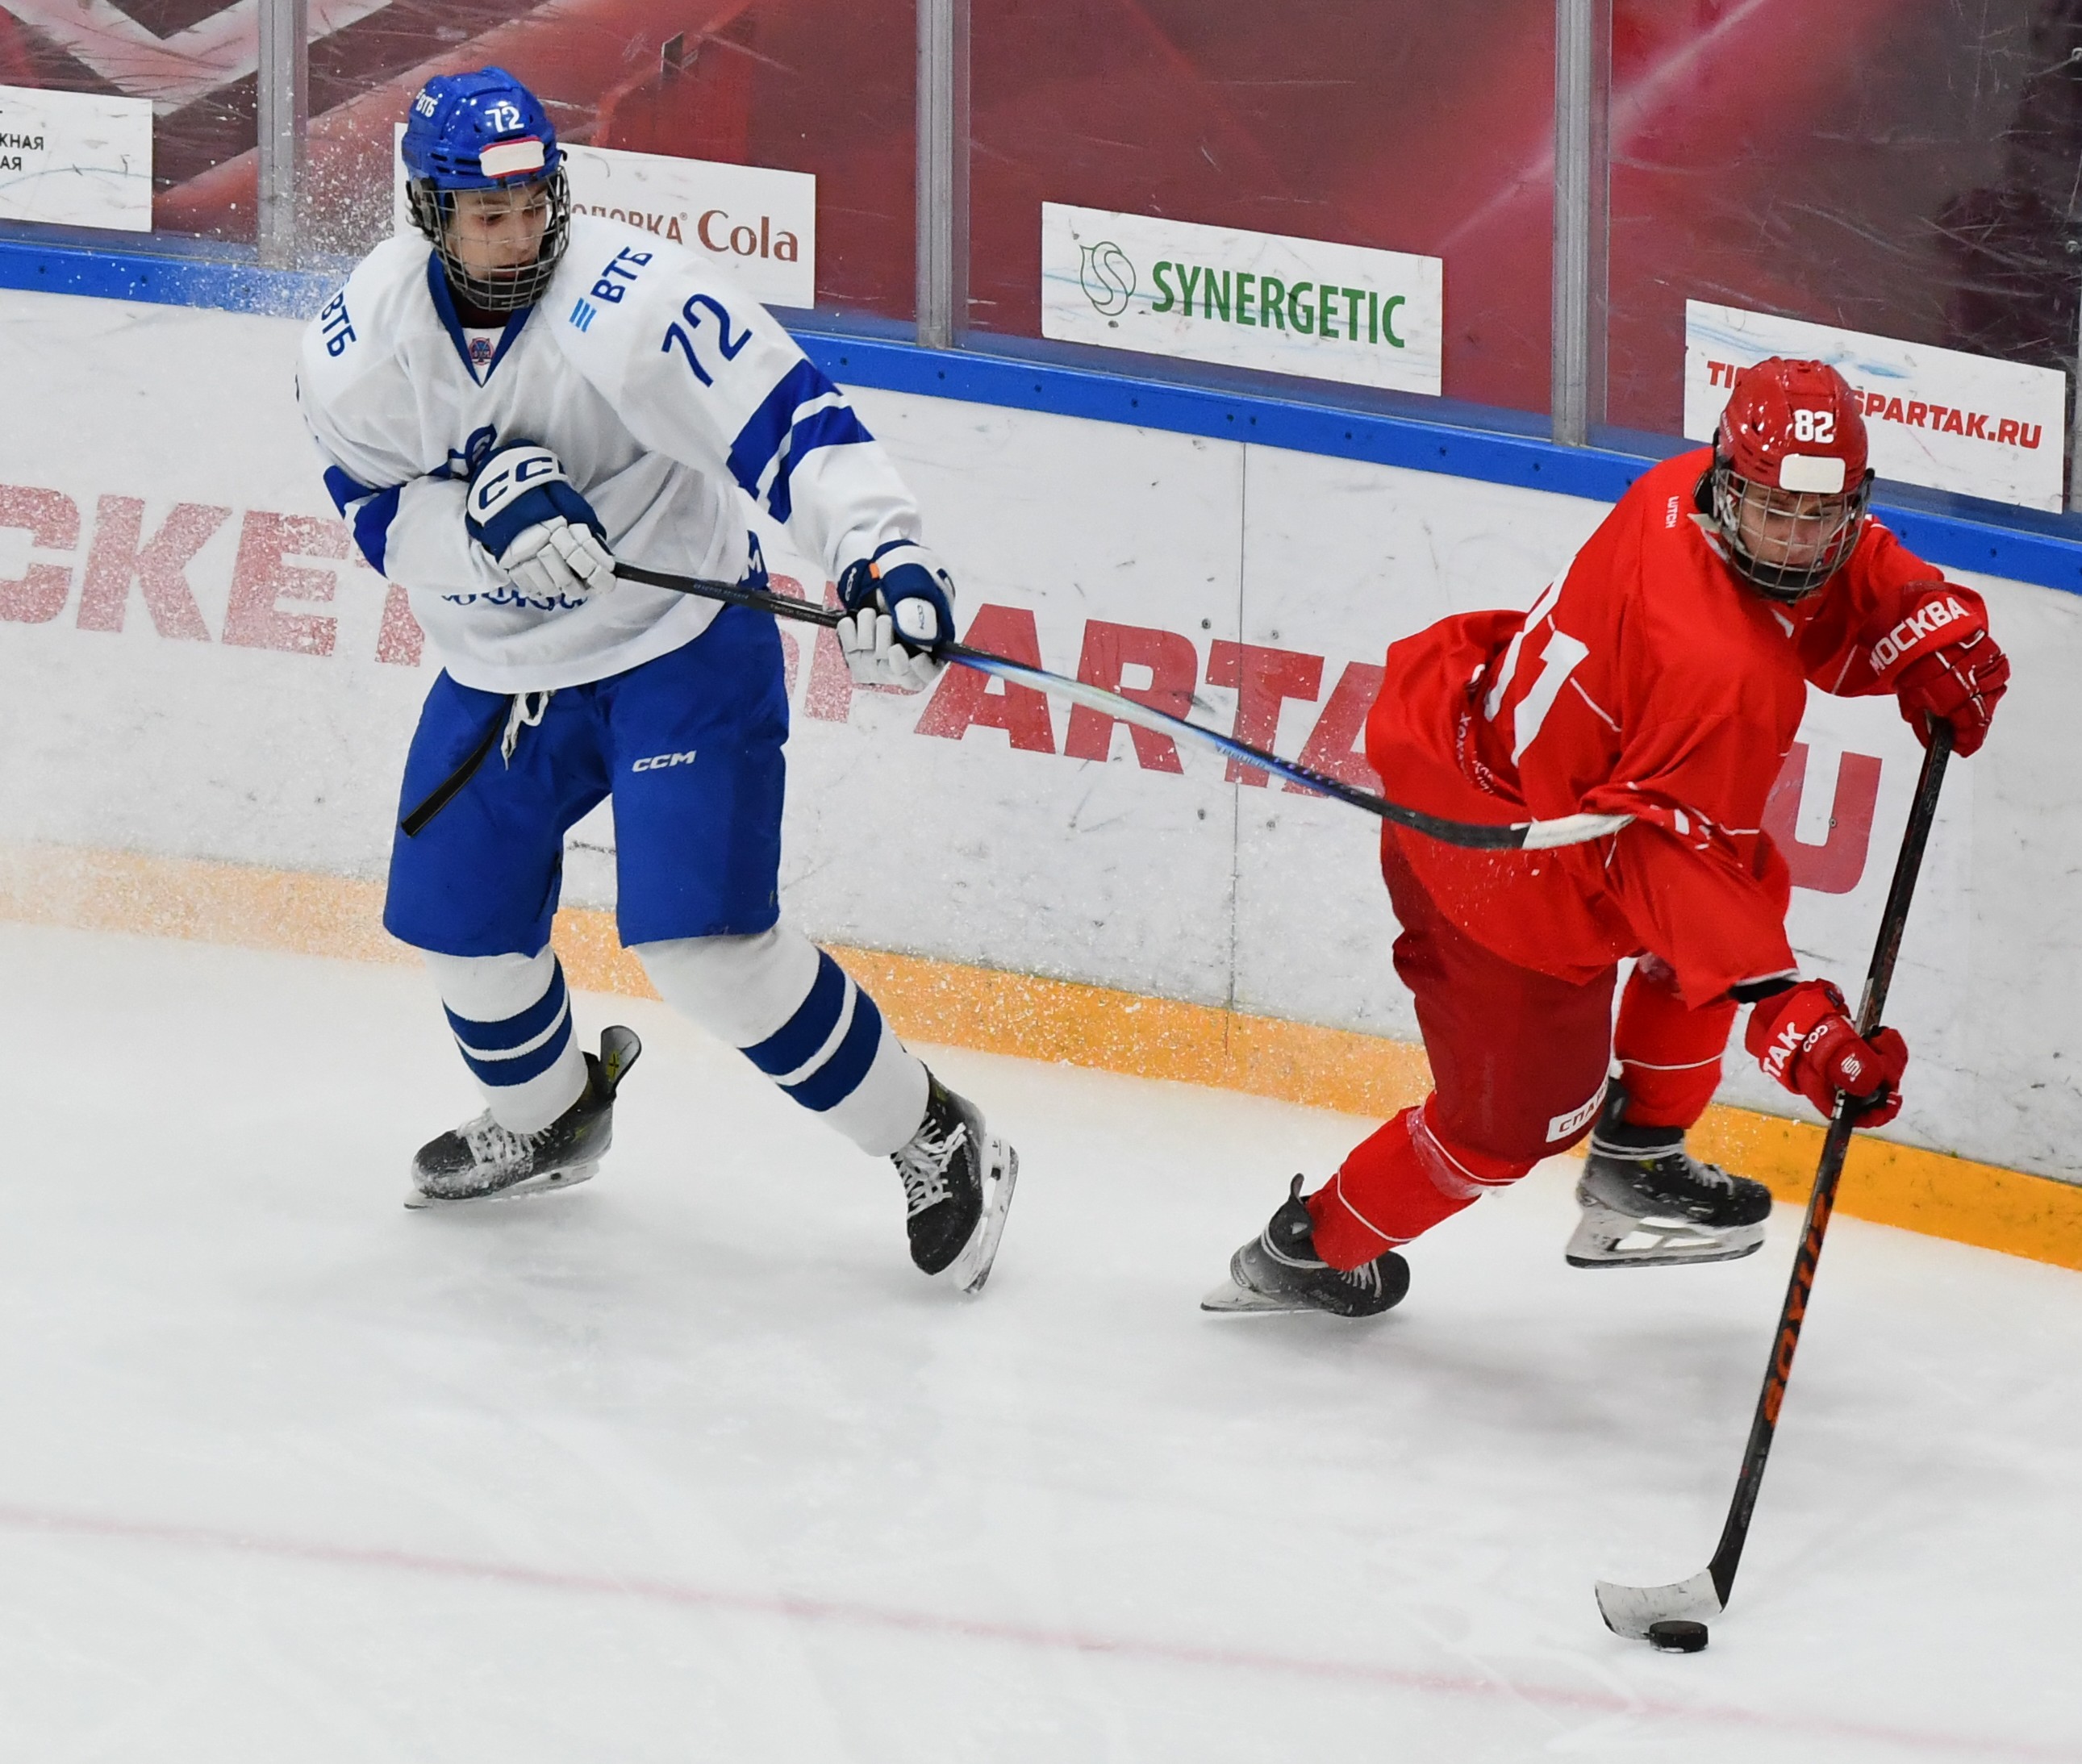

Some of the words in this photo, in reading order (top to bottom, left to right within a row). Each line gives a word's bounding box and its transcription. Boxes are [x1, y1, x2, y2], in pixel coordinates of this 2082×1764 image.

[415, 95, 438, 118] ВТБ
[485, 106, 524, 132] 72
[697, 210, 798, 262] Cola
[590, 246, 653, 304] ВТБ
[321, 291, 357, 357] ВТБ
[1152, 261, 1406, 348] SYNERGETIC
[661, 294, 753, 388] 72
[1794, 409, 1834, 444] 82
[1850, 390, 2042, 449] SPARTAK.RU
[478, 457, 565, 510] CC
[1869, 597, 1969, 676] МОСКВА
[632, 750, 697, 773] CCM
